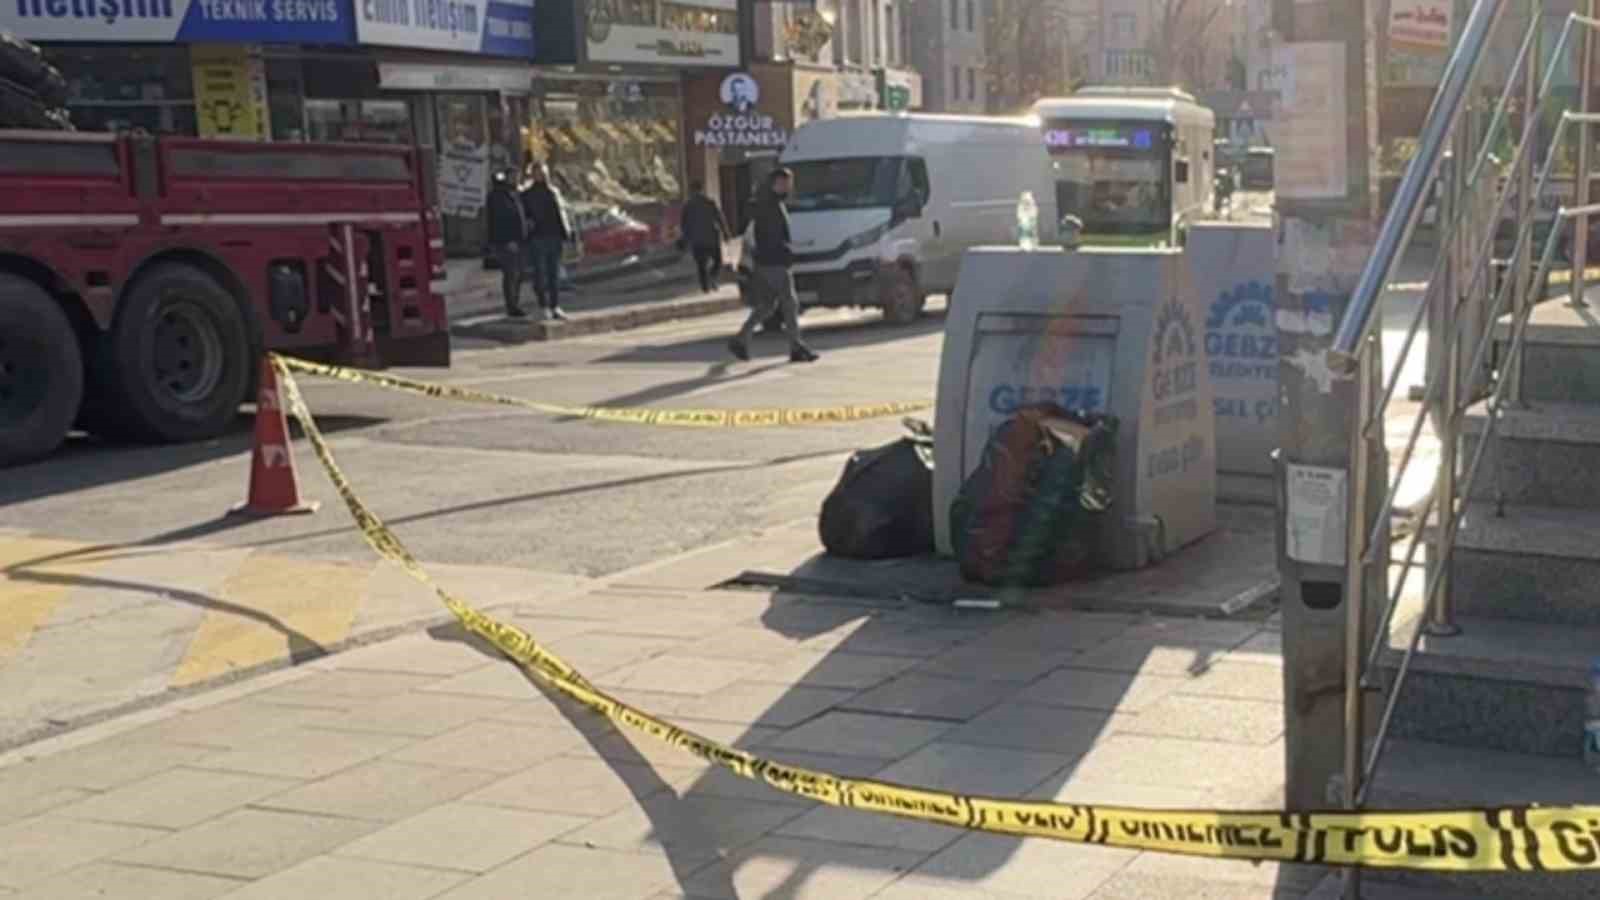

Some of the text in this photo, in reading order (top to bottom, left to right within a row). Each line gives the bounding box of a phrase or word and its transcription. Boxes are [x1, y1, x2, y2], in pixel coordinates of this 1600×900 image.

[708, 113, 774, 130] ÖZGÜR
[694, 130, 788, 146] PASTANESİ
[1205, 332, 1279, 358] GEBZ
